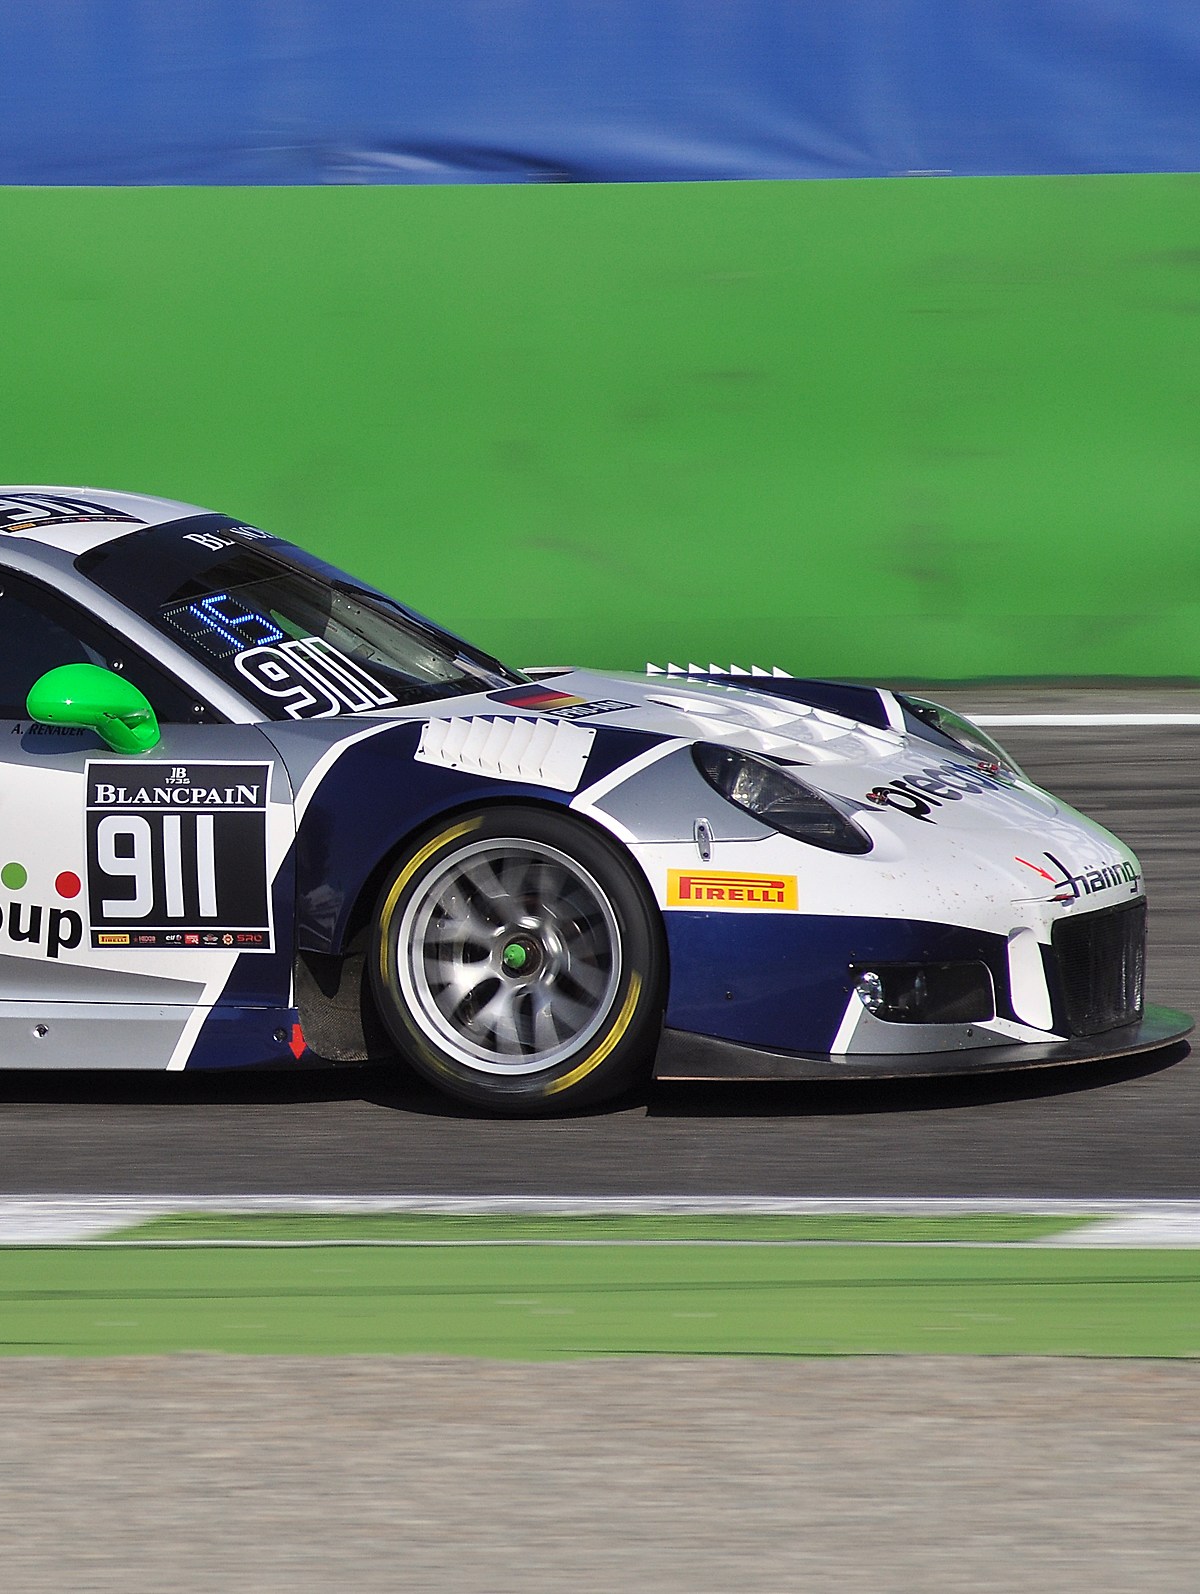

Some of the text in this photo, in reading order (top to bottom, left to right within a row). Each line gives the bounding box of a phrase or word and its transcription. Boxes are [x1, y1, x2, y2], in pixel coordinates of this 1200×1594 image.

[234, 636, 399, 721] 911
[11, 723, 24, 735] A.
[94, 784, 260, 805] BLANCPAIN
[97, 814, 219, 918] 911
[678, 875, 785, 903] PIRELLI
